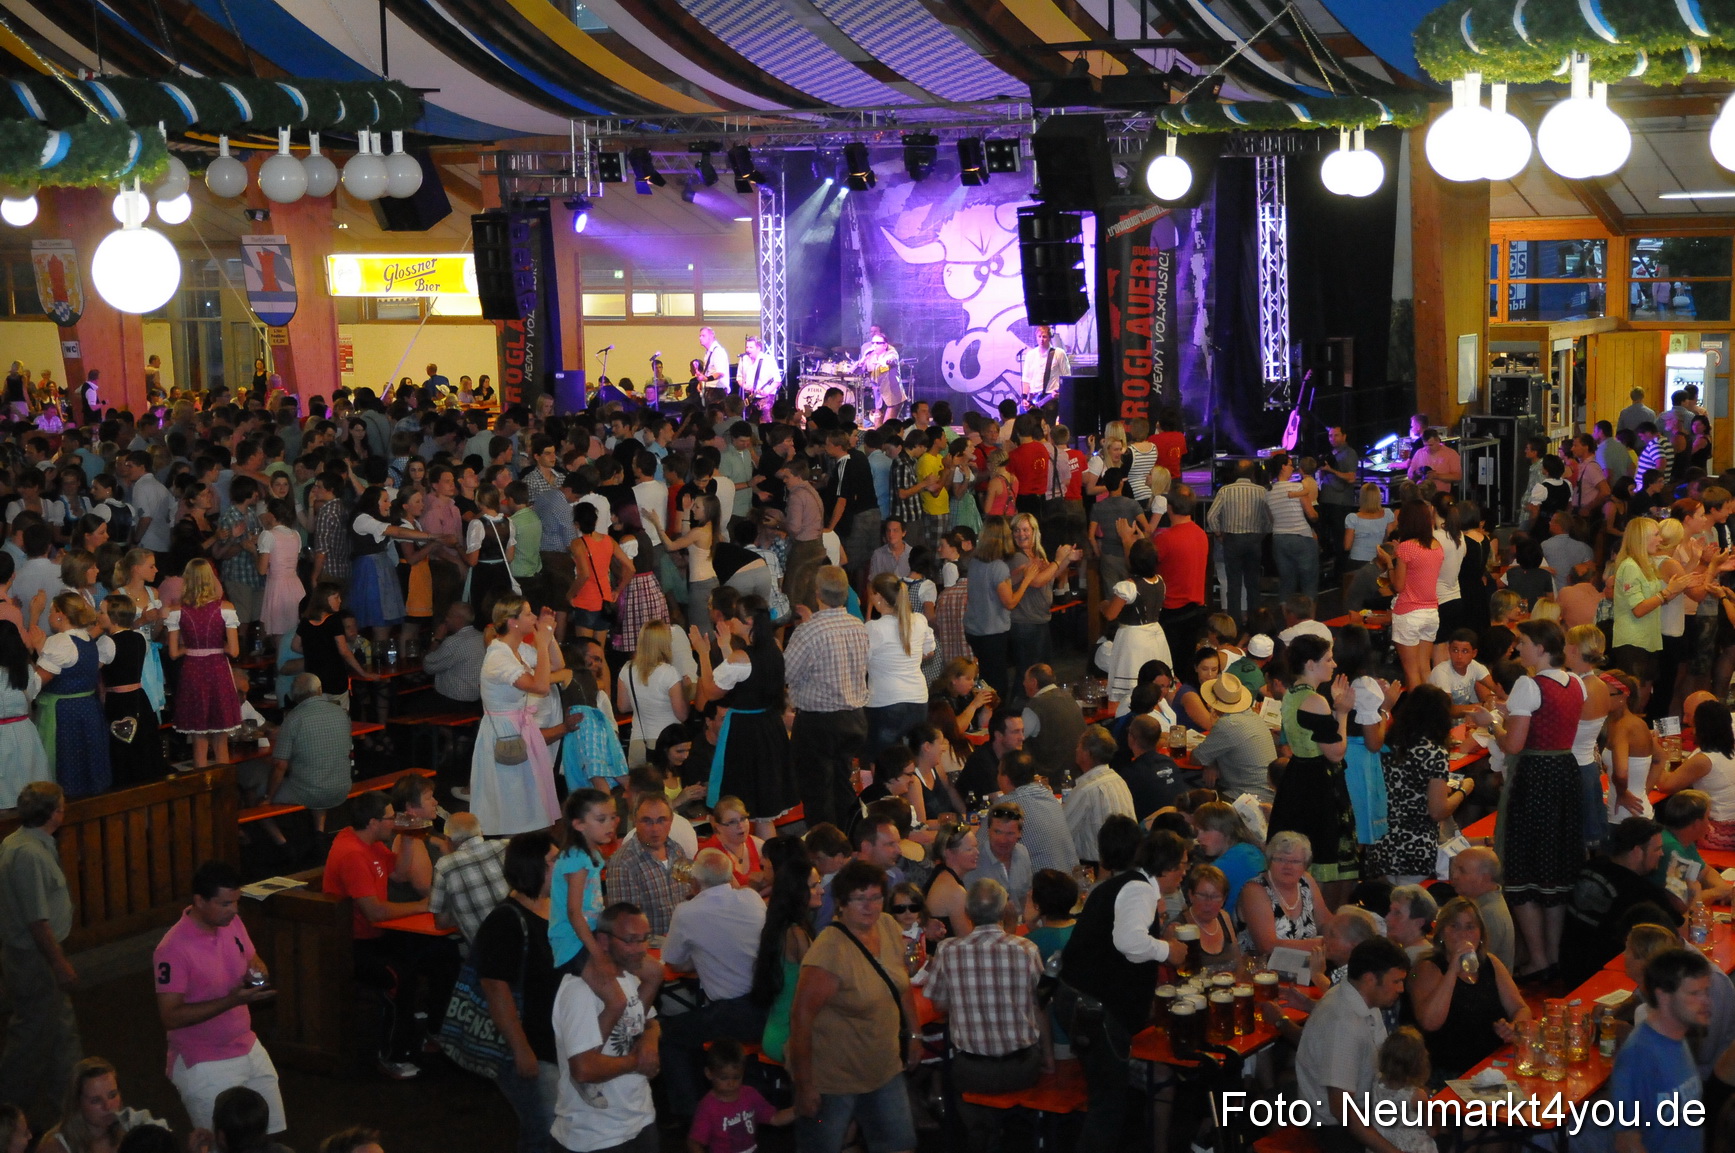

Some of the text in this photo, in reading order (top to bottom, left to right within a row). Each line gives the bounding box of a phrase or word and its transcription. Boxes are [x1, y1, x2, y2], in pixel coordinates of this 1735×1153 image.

[384, 258, 438, 292] Glossner
[415, 278, 441, 291] Bier
[1152, 251, 1170, 394] HEAVY VOLXMUSIC!
[64, 345, 77, 353] WC
[524, 342, 534, 382] HEAVY
[158, 963, 170, 983] 3
[745, 1119, 754, 1134] 8
